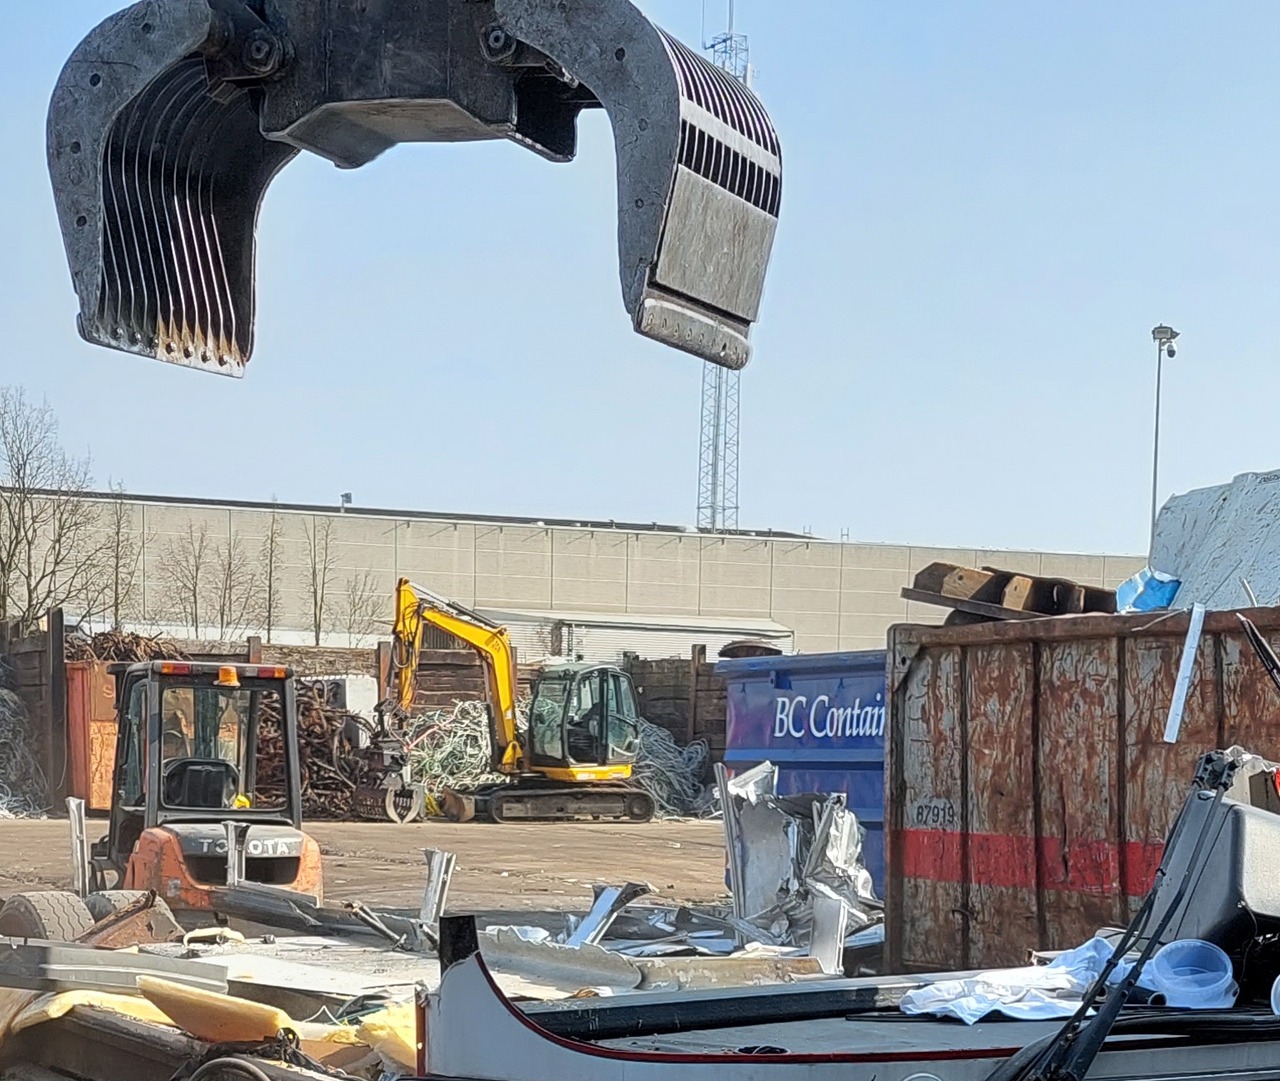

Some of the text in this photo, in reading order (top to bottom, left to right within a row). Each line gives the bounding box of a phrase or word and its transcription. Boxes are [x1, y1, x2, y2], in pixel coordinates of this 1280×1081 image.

[773, 695, 807, 738] BC
[916, 804, 956, 825] 87919
[198, 837, 290, 855] TOOTA
